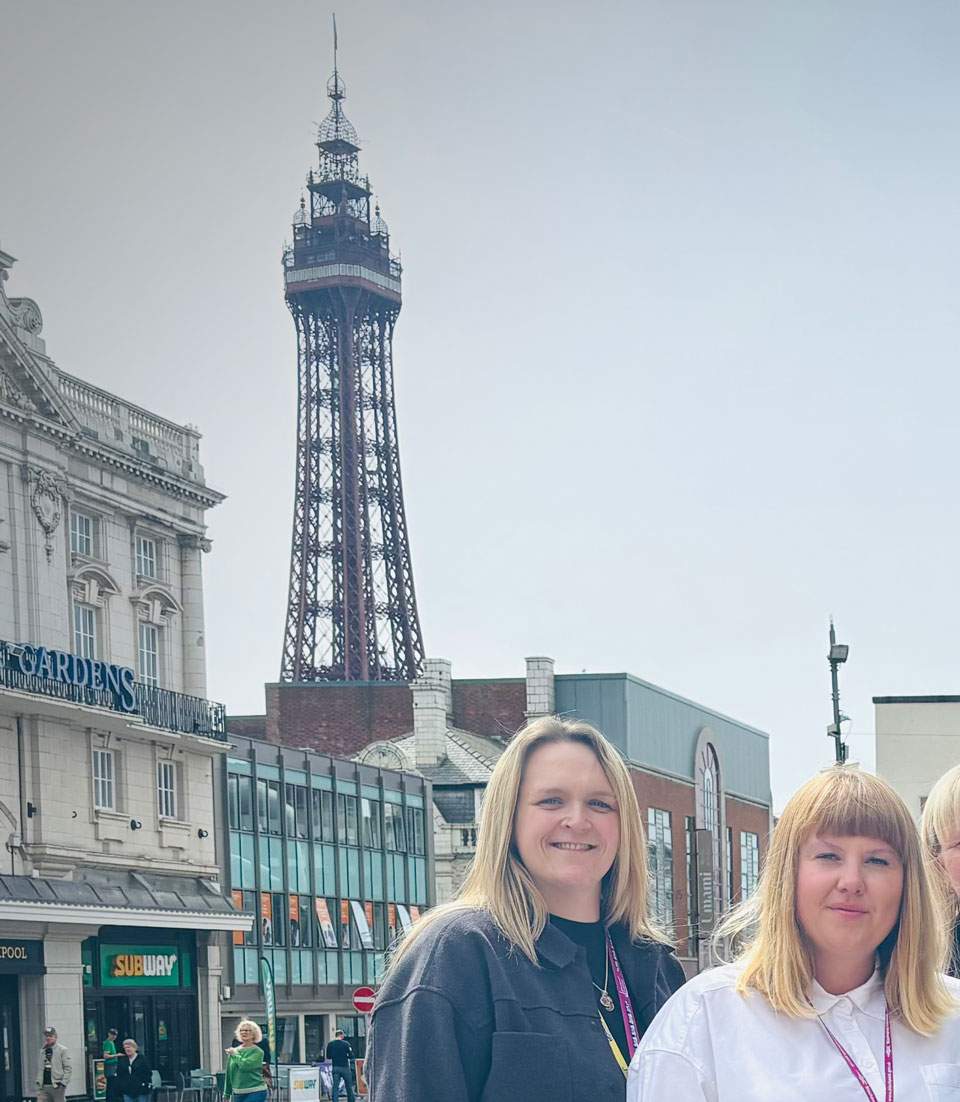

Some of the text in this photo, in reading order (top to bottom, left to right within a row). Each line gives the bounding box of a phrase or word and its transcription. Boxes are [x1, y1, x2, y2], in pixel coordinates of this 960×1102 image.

[18, 642, 136, 711] GARDENS
[114, 954, 177, 977] SUBWAY
[293, 1079, 316, 1090] SUBWAY
